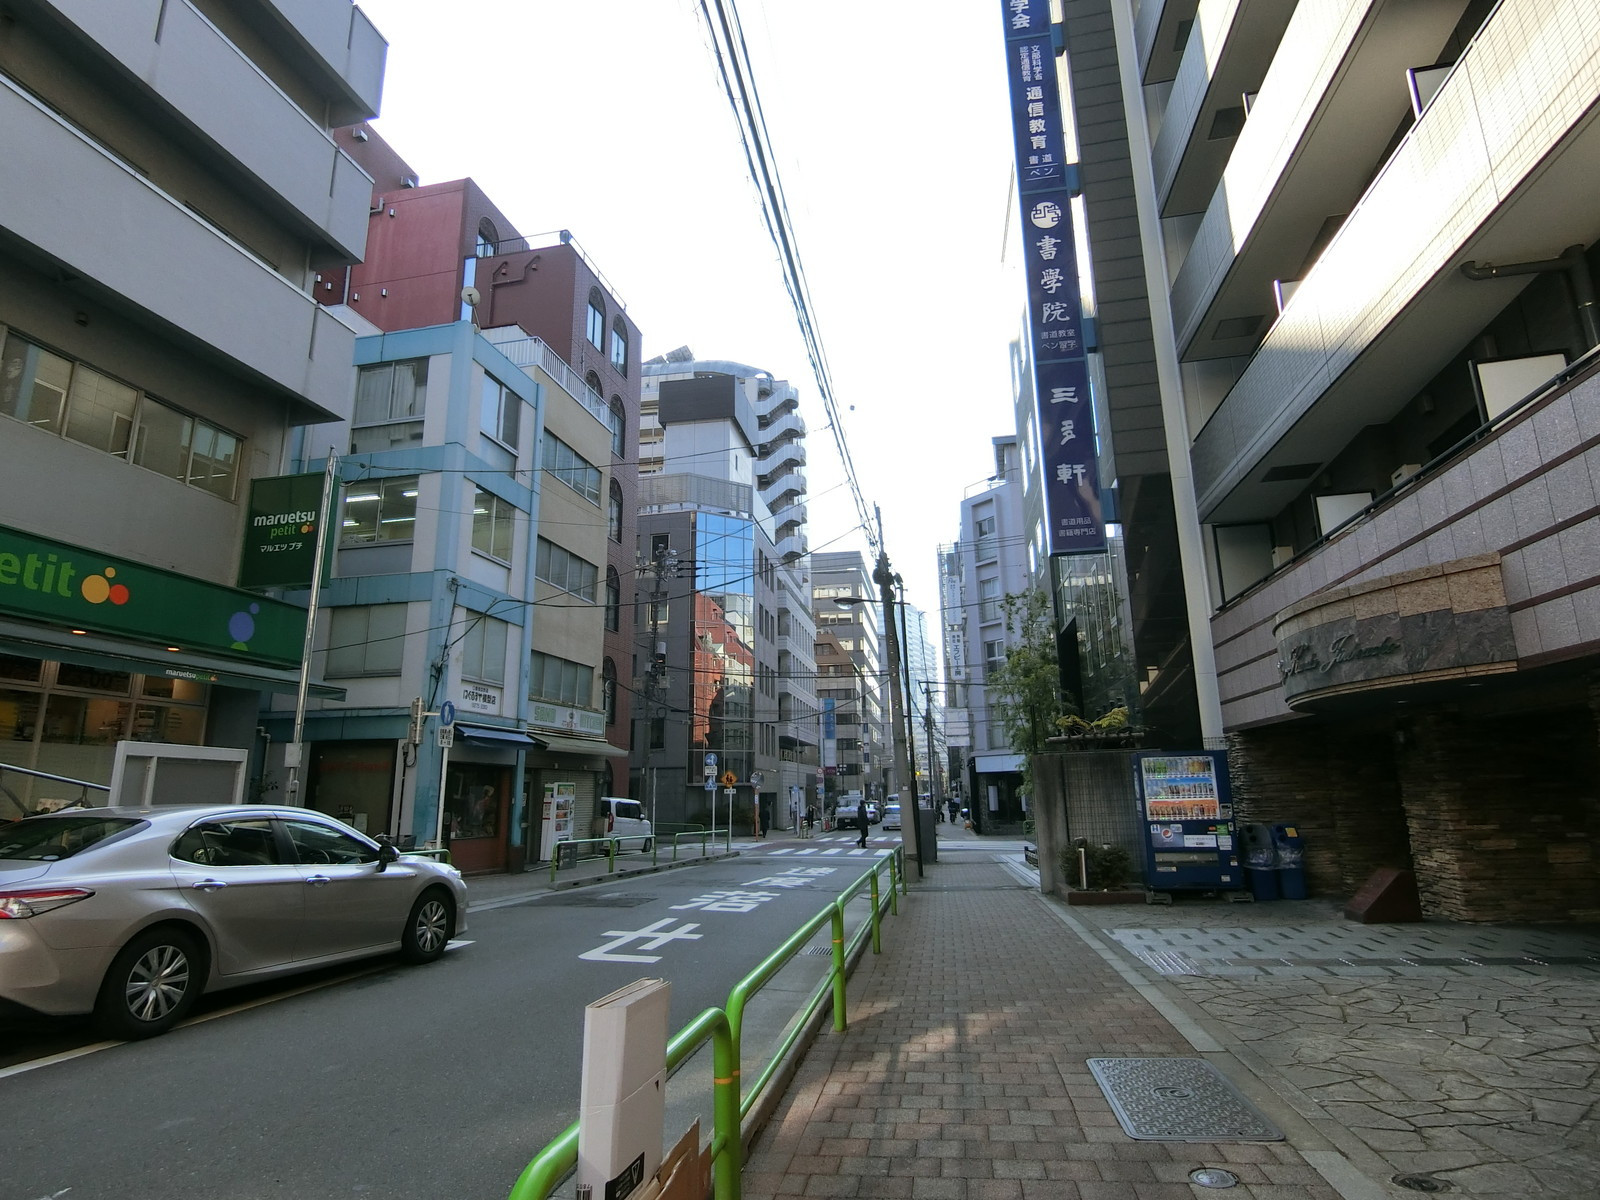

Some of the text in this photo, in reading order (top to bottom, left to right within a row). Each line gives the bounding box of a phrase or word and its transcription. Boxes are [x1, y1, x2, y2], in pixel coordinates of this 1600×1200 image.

[1010, 0, 1031, 30] 学会
[1031, 44, 1043, 81] 文部科学省
[1026, 85, 1047, 150] 通信教育
[1028, 153, 1053, 165] 書道
[1030, 167, 1053, 176] ペン
[1040, 328, 1076, 340] 書道教室
[1041, 340, 1078, 351] ペン習字
[1050, 386, 1087, 487] 三多軒
[253, 510, 316, 527] maruetsu
[1060, 516, 1092, 526] 書道用品
[270, 524, 297, 540] petit
[1058, 527, 1097, 537] 書籍専門店
[260, 541, 303, 553] マルエツ プチ
[165, 669, 197, 679] maruetsu
